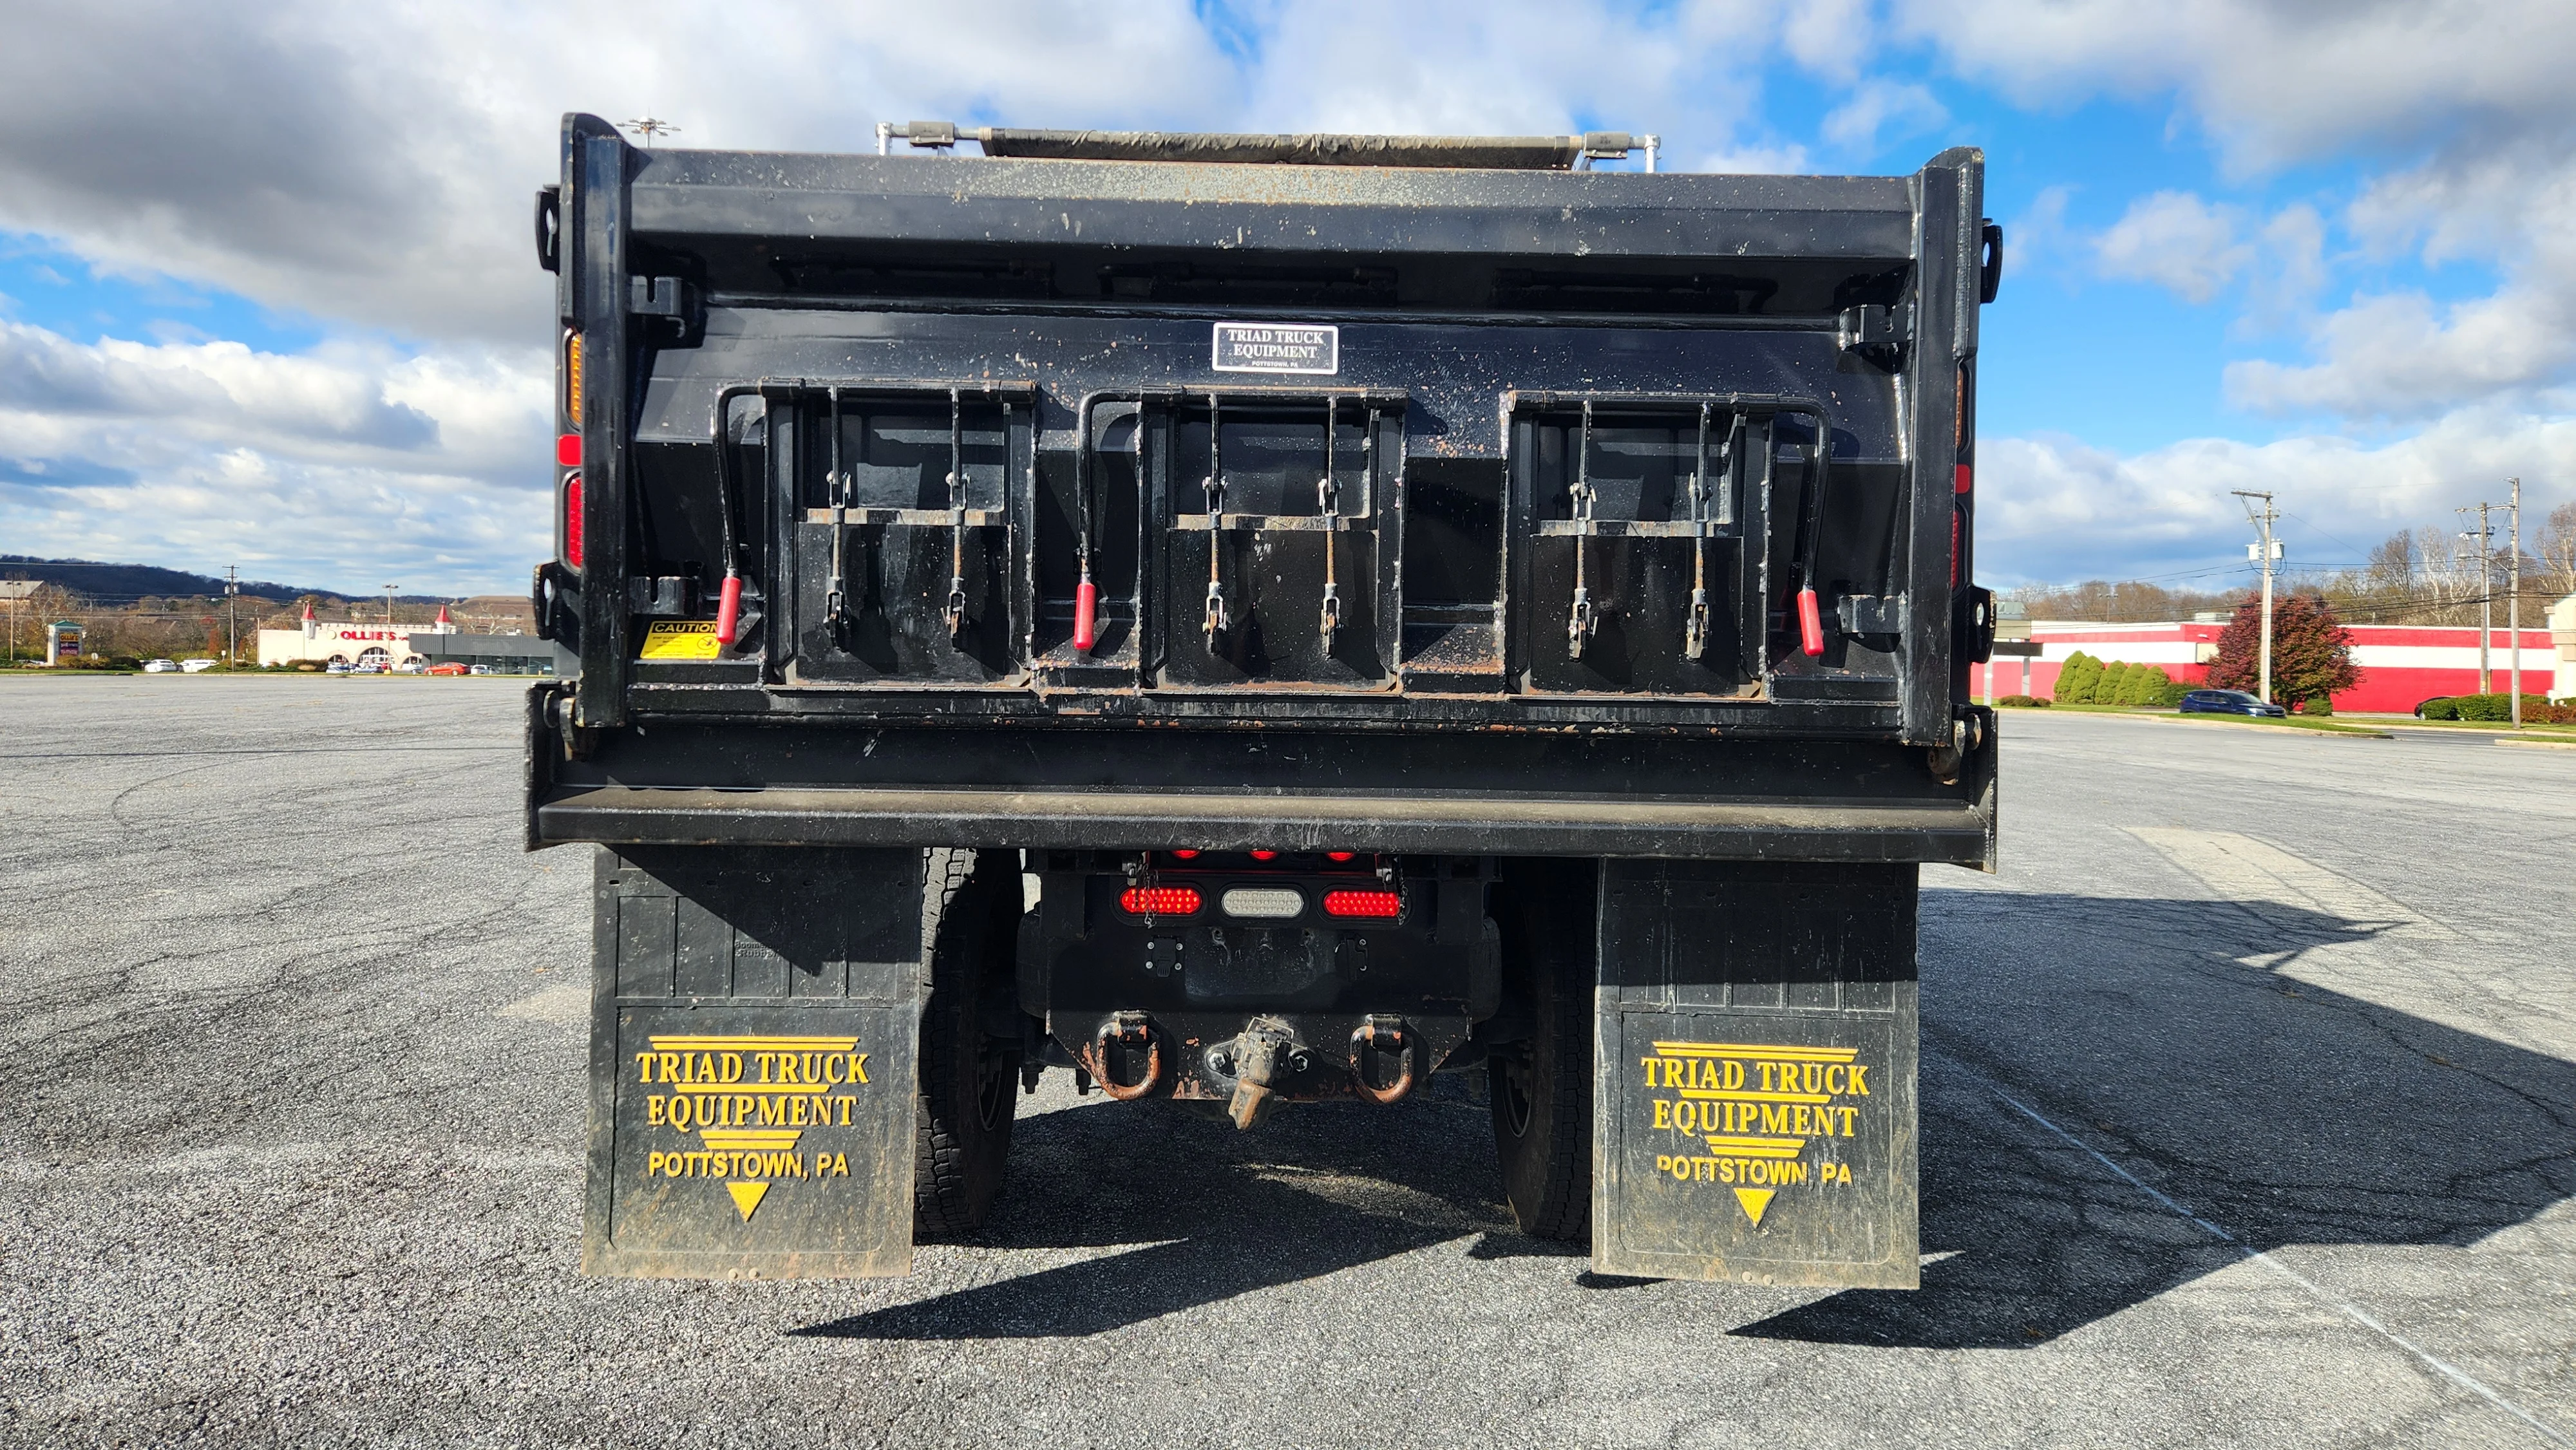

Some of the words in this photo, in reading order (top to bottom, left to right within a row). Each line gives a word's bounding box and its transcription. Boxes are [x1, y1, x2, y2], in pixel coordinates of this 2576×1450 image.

[1227, 329, 1271, 343] TRIAD
[1275, 331, 1324, 344] TRUCK
[1234, 344, 1318, 359] EQUIPMENT
[636, 1053, 743, 1084] TRIAD
[755, 1053, 870, 1084] TRUCK
[1641, 1057, 1745, 1091] TRIAD
[1756, 1062, 1870, 1095] TRUCK
[647, 1095, 857, 1132] EQUIPMENT
[1653, 1099, 1859, 1137] EQUIPMENT
[649, 1152, 809, 1181] POTTSTOWN,
[816, 1152, 849, 1177] PA
[1821, 1163, 1854, 1187] PA
